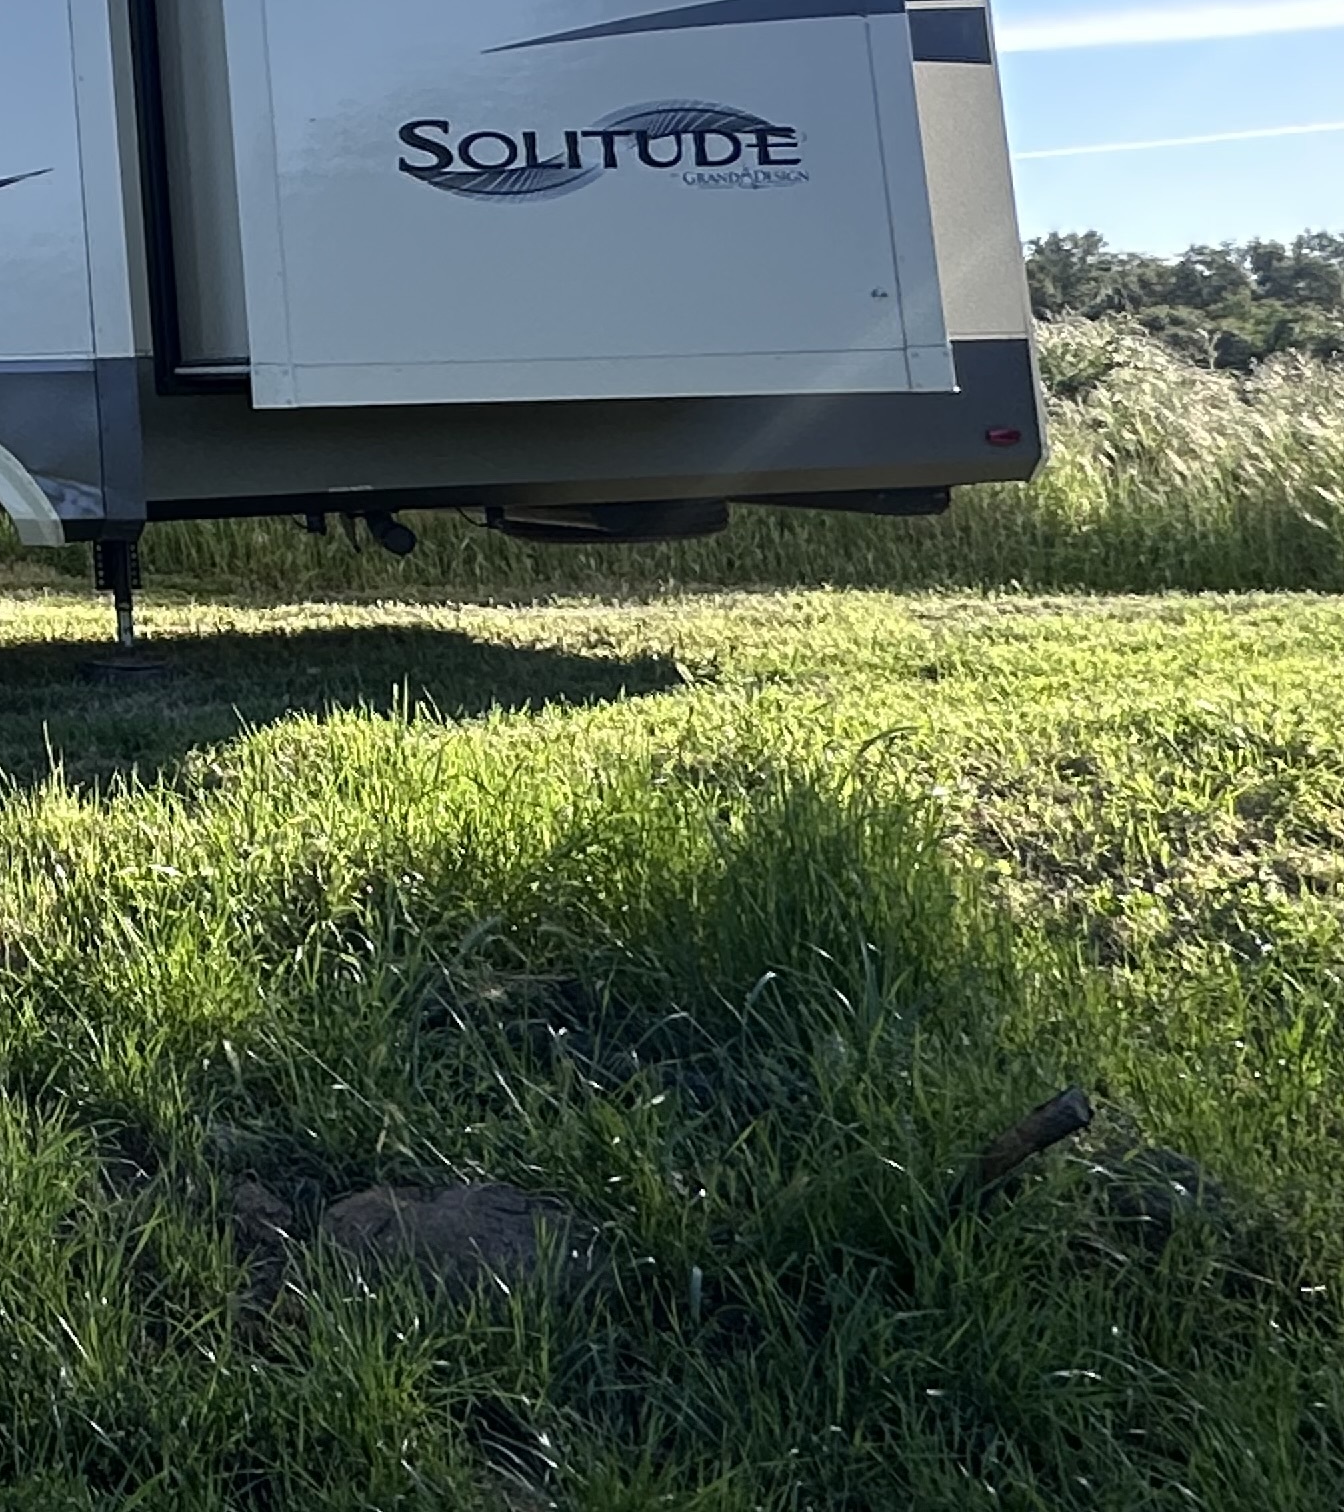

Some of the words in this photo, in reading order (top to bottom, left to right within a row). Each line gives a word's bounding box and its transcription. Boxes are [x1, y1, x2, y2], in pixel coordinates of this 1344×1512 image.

[398, 119, 802, 171] SOLITUDE
[682, 171, 739, 186] GRAND
[753, 169, 810, 185] DESIGN
